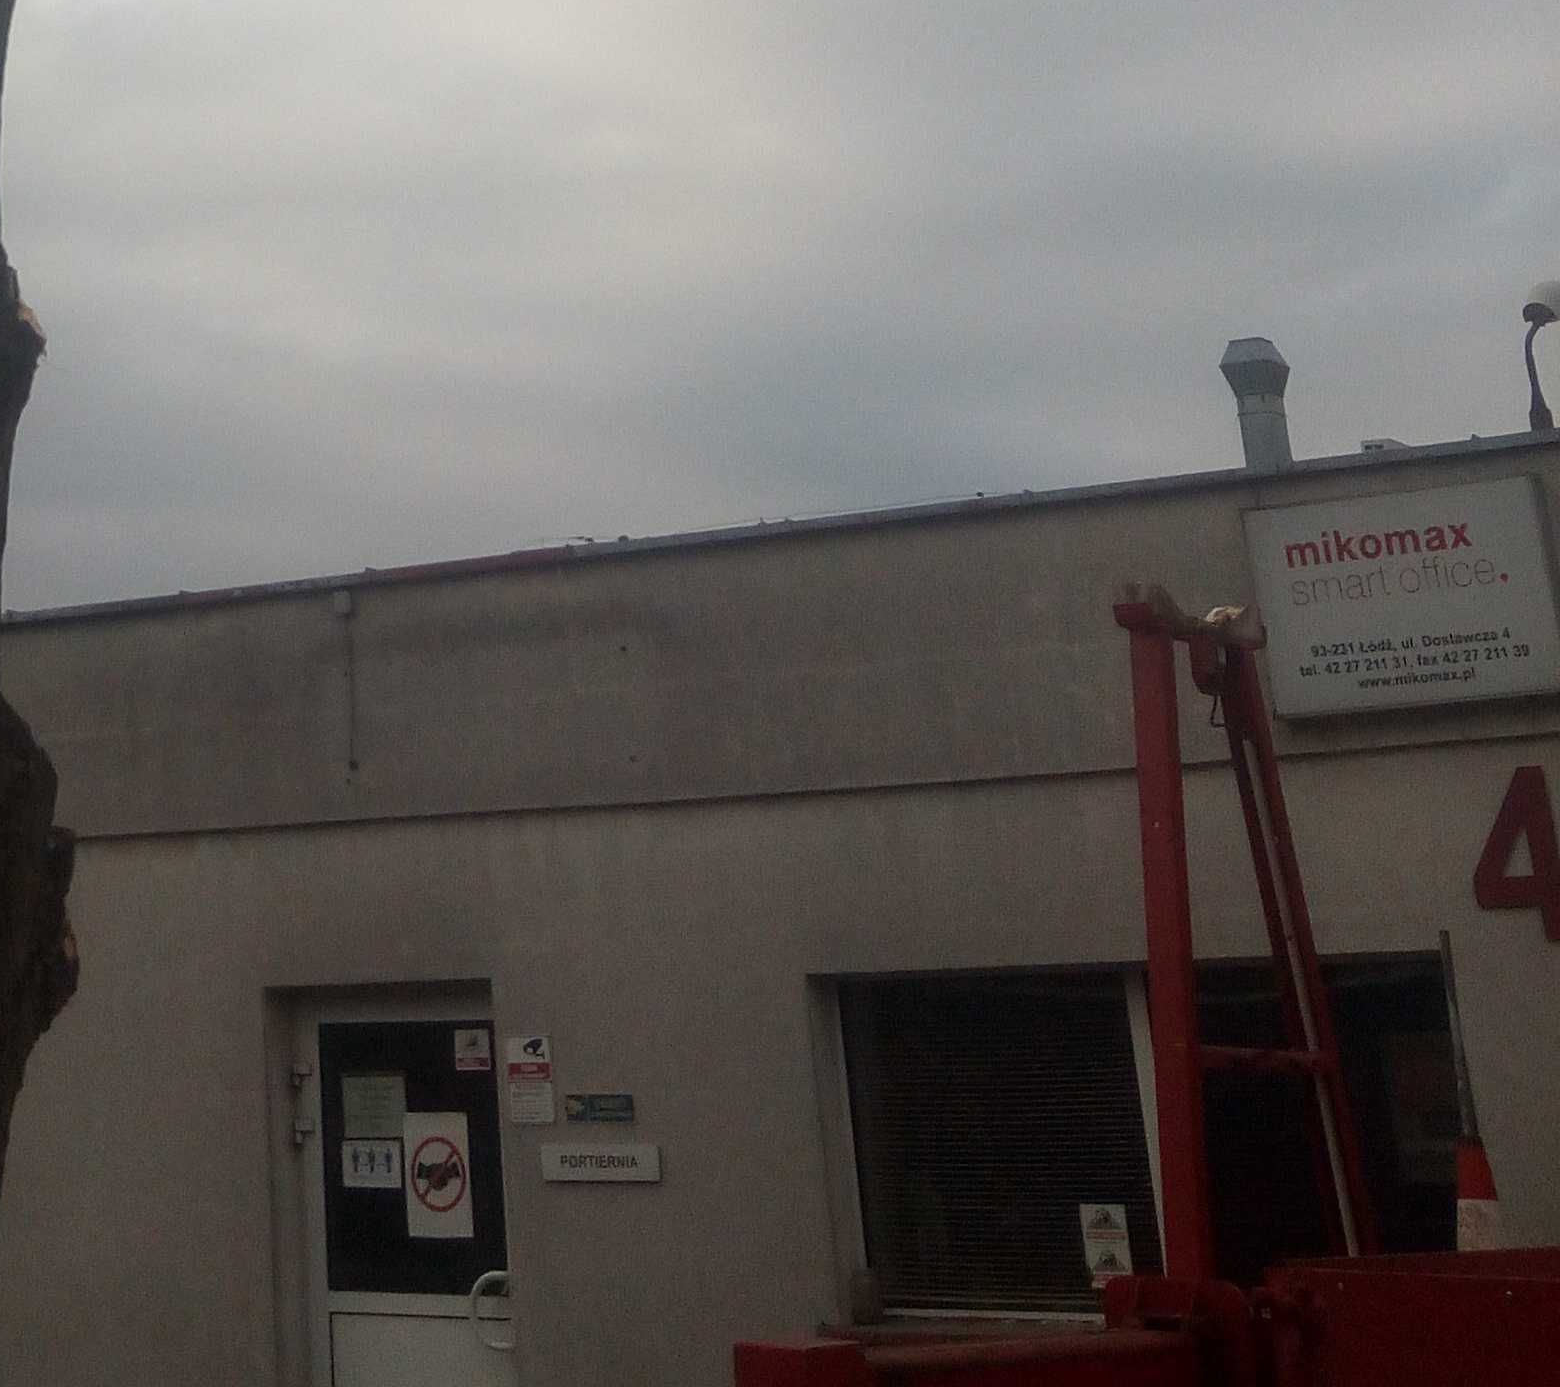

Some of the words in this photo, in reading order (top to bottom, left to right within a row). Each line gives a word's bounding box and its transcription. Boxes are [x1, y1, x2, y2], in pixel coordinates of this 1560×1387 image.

[1285, 523, 1473, 569] mikomax
[1290, 565, 1393, 606] smart
[1421, 630, 1499, 648] Dostawcza
[1502, 626, 1512, 640] 4
[1299, 665, 1321, 679] tel.
[1324, 661, 1341, 675] 42
[1343, 660, 1360, 674] 27
[1365, 657, 1388, 672] 211
[1415, 652, 1440, 667] fax
[1442, 651, 1460, 665] 42
[1462, 649, 1480, 663] 27
[1484, 646, 1508, 661] 211
[1356, 667, 1477, 689] www.mikomax.pl
[1473, 765, 1560, 942] 4
[559, 1154, 639, 1169] PORTIERNIA
